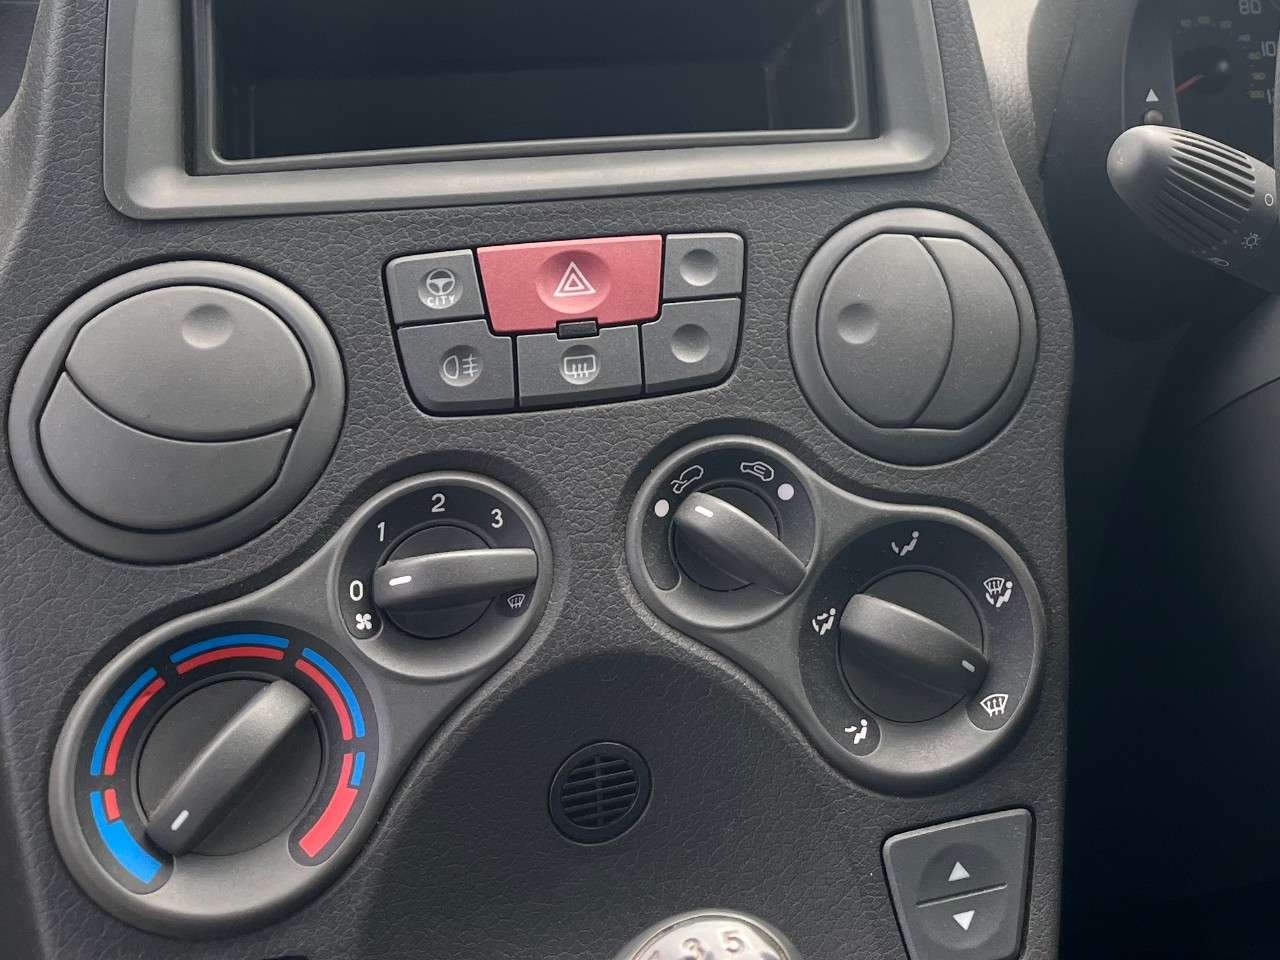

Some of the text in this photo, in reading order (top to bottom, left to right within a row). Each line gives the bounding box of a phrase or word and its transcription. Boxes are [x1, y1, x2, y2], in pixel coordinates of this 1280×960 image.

[426, 294, 456, 307] CITY
[431, 493, 446, 513] 2
[490, 508, 504, 529] 3
[377, 521, 386, 542] 1
[349, 579, 364, 602] 0
[722, 929, 745, 954] 5
